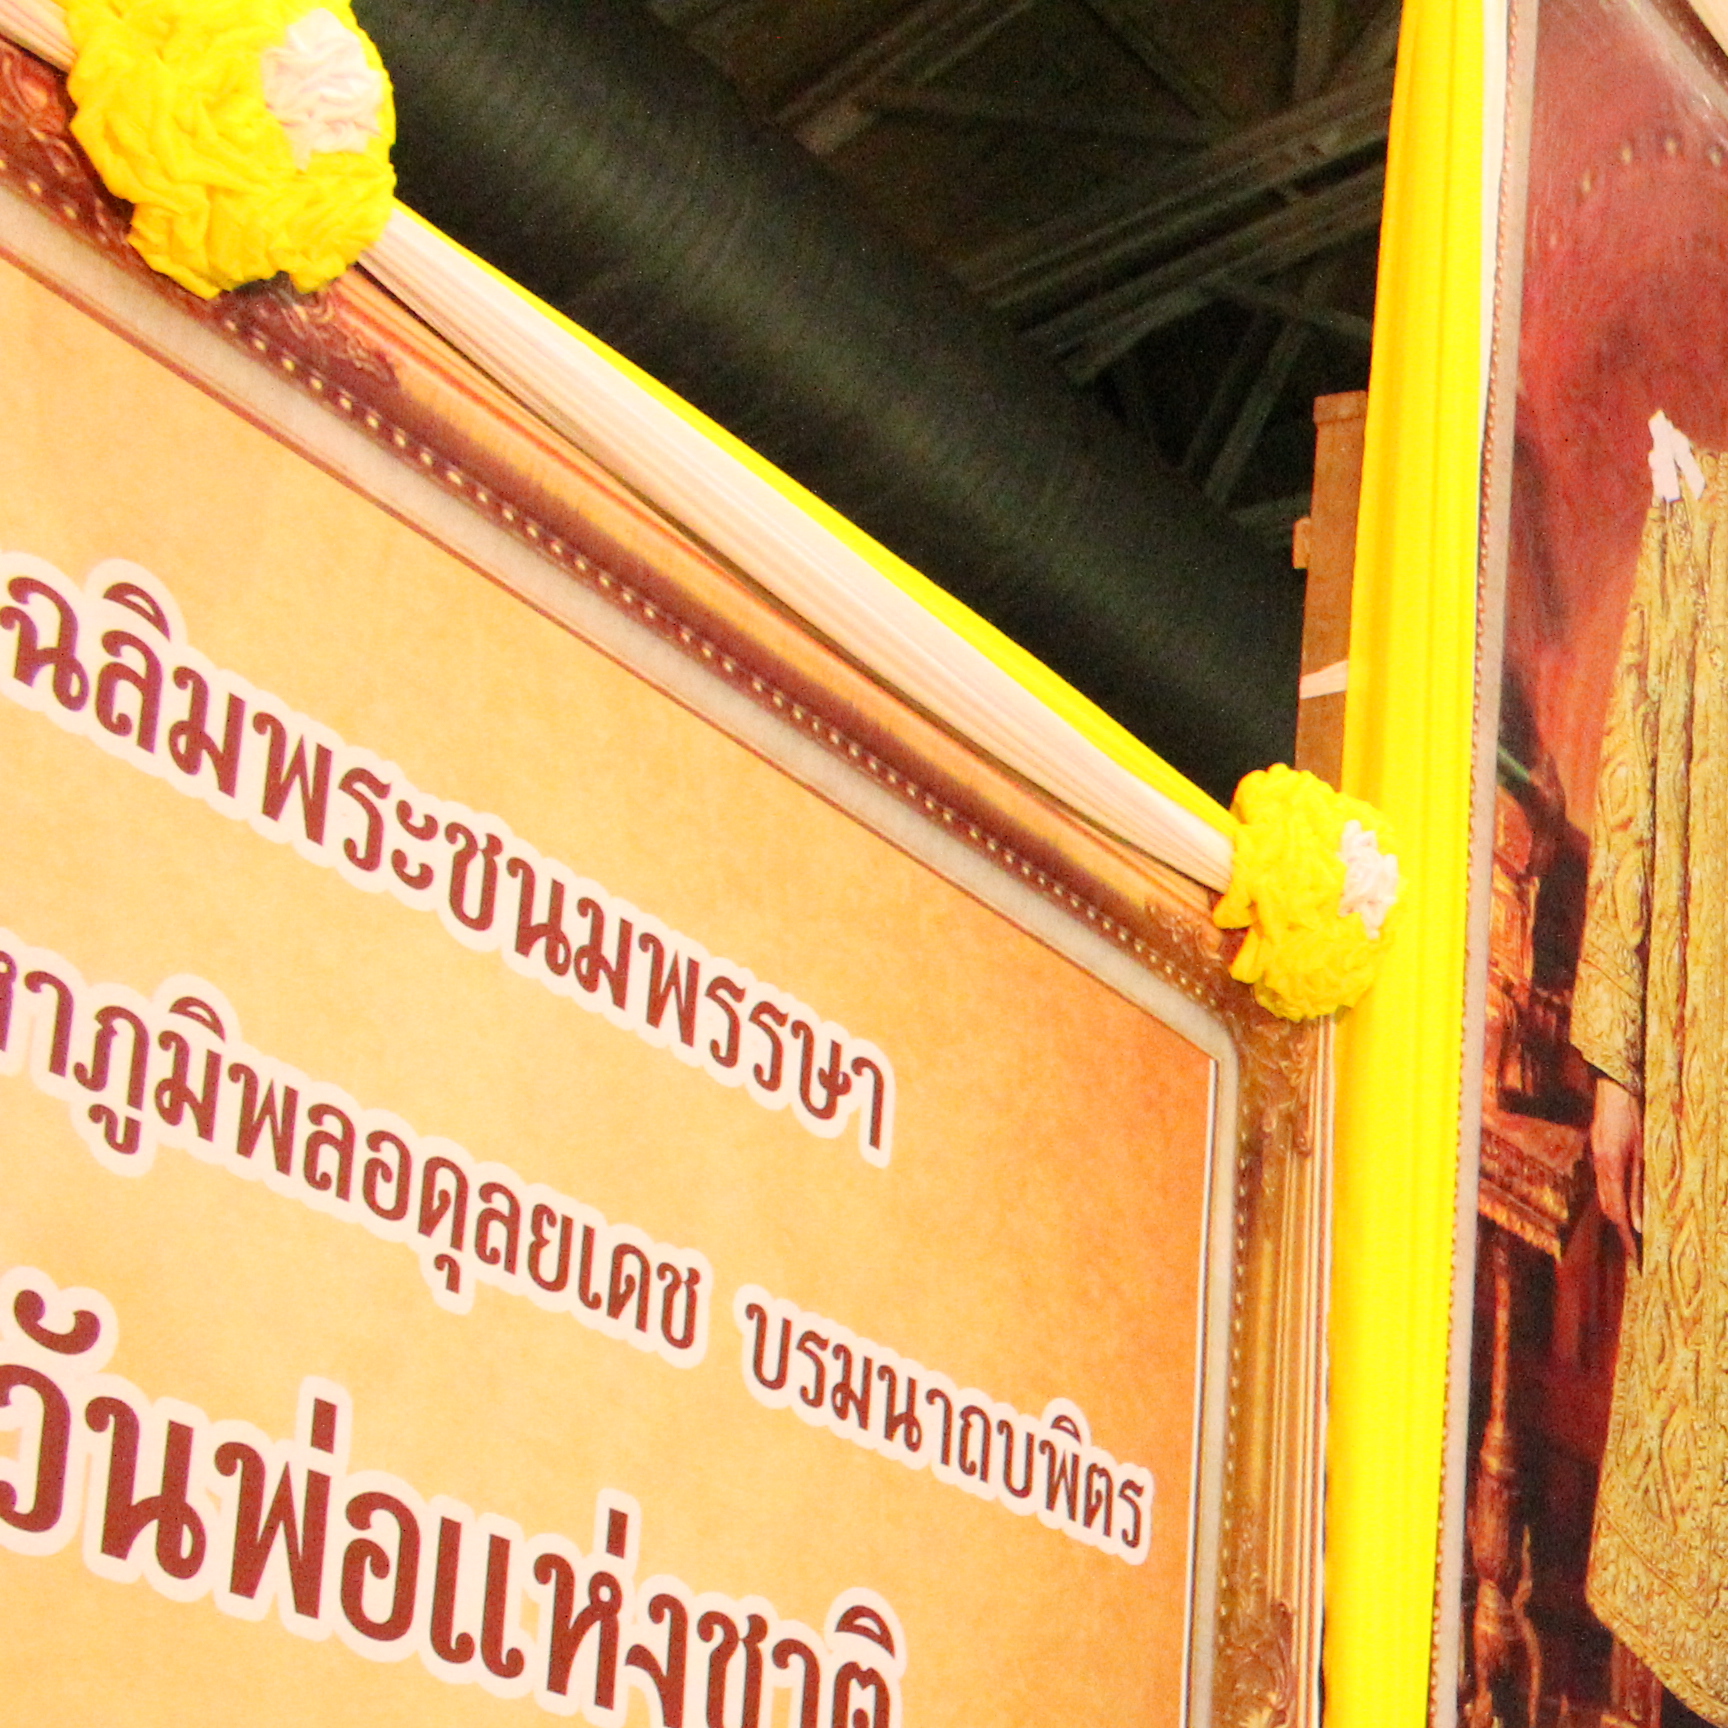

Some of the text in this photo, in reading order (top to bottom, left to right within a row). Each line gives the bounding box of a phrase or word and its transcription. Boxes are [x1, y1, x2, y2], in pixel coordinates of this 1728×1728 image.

[746, 1303, 1144, 1549] บรมนาถบพิตร
